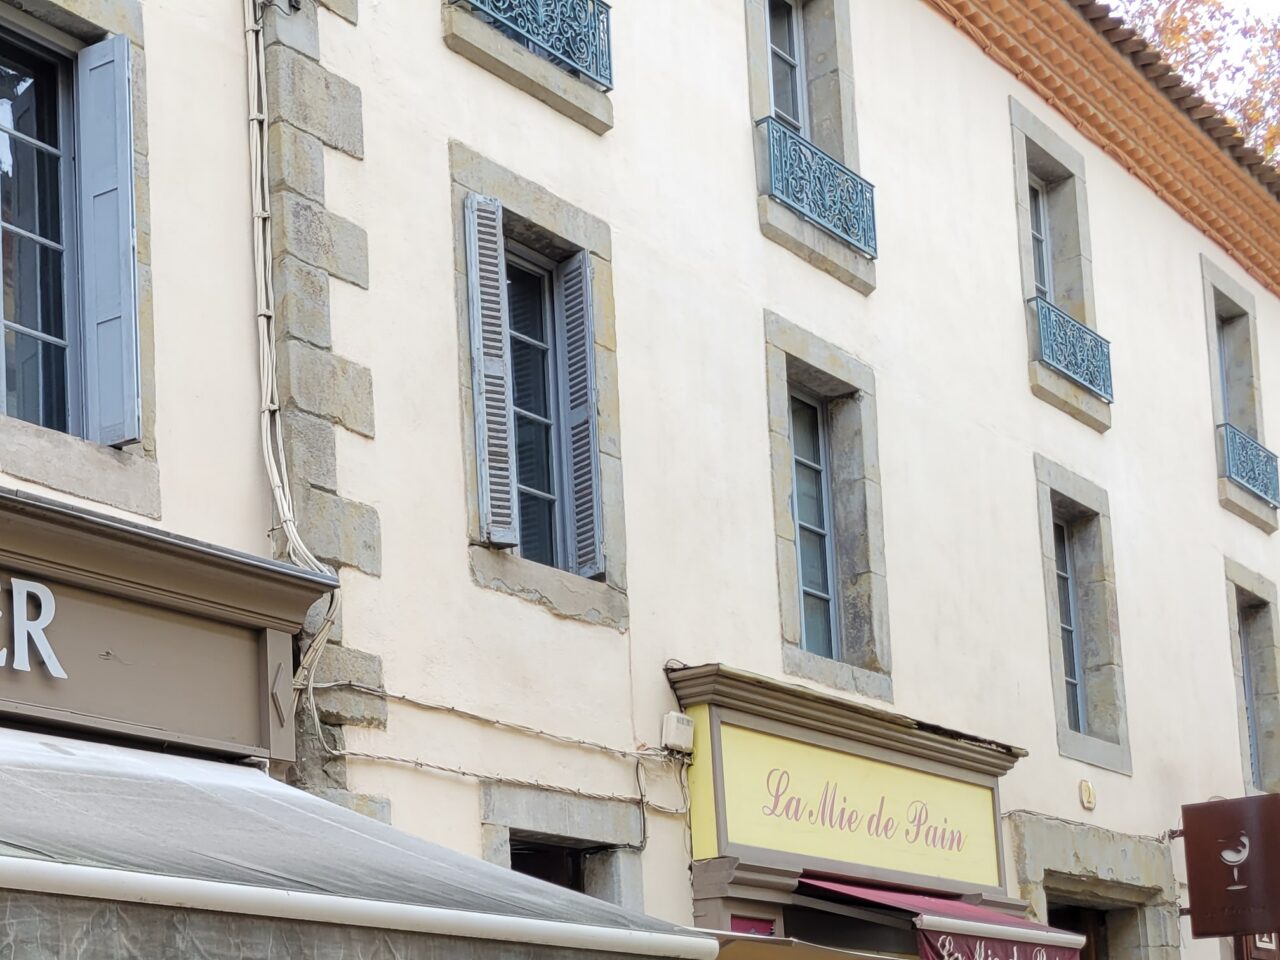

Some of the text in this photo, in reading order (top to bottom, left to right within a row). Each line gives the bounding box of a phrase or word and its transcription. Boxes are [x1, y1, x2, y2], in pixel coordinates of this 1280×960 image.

[762, 768, 968, 852] La Mie de Pain
